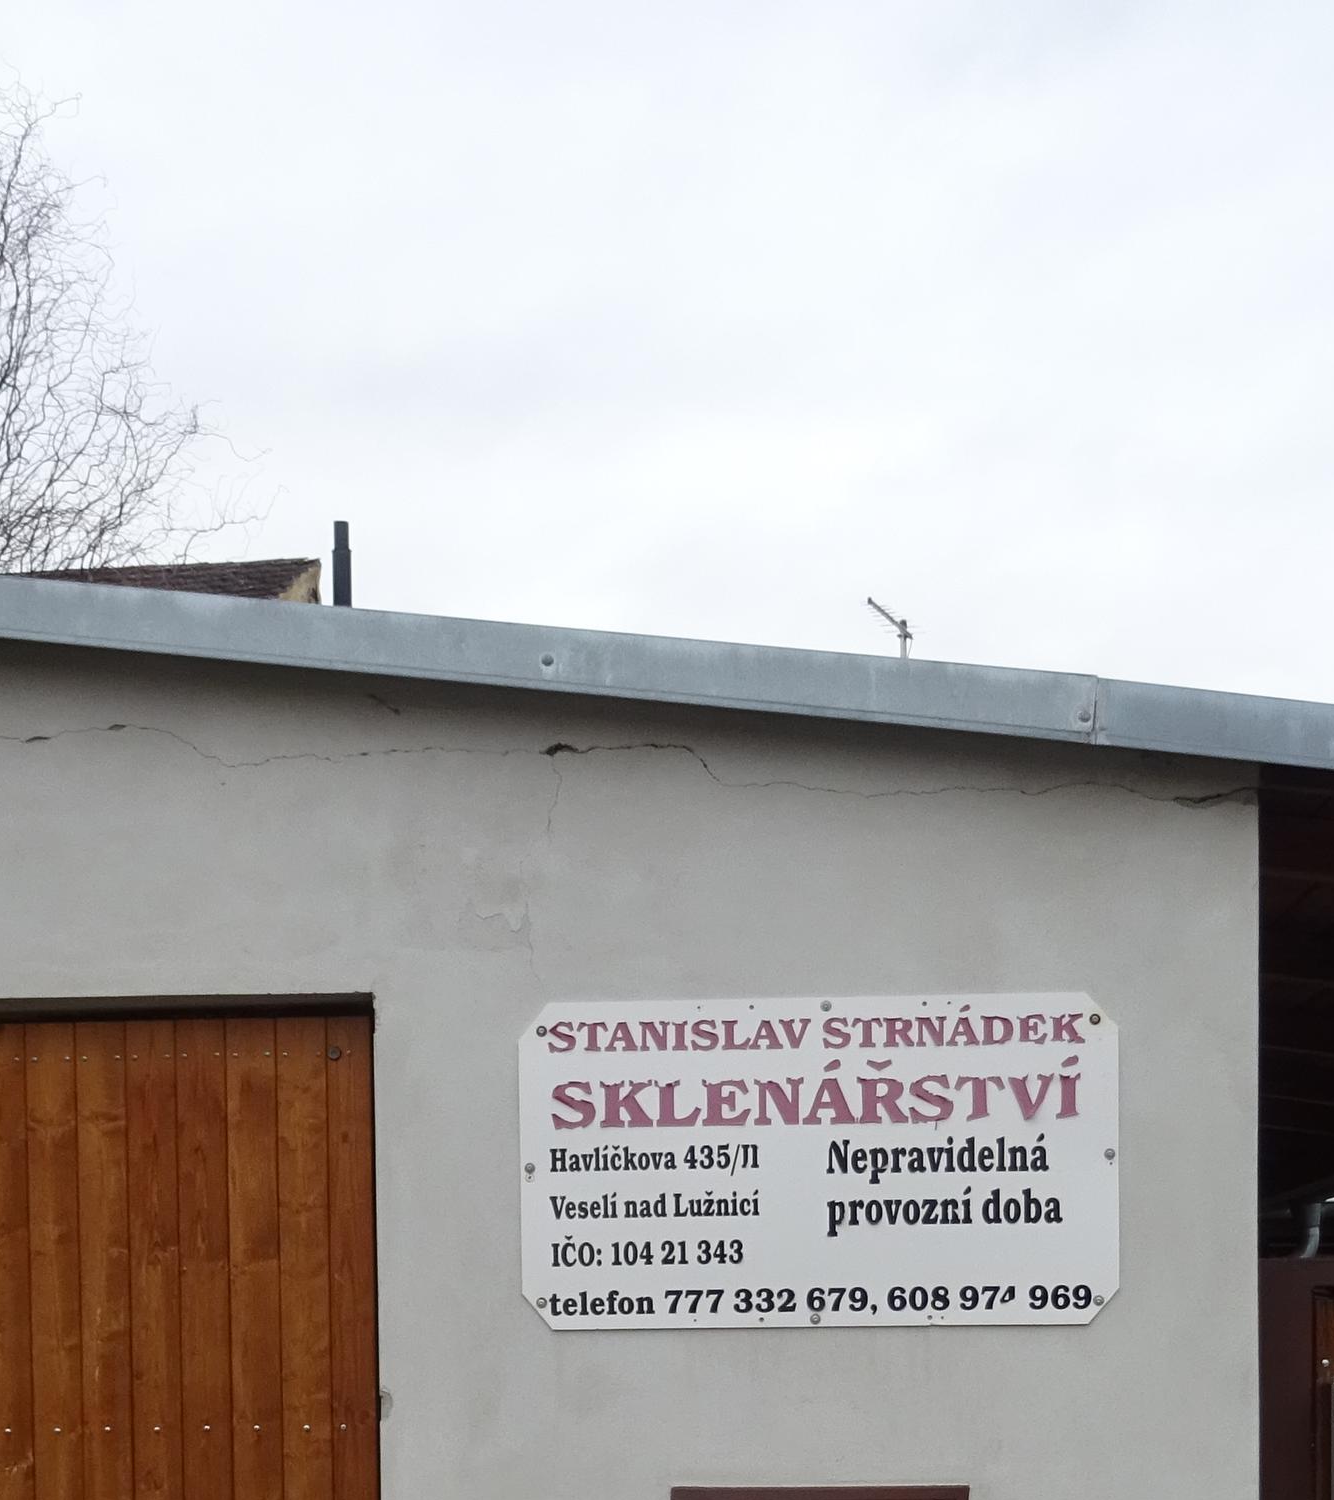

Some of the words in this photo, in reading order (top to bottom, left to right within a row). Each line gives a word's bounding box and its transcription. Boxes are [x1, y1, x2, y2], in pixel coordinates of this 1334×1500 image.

[548, 1018, 811, 1053] STANISLAV
[822, 1004, 1086, 1048] STRNÁDEK
[551, 1055, 1081, 1130] SKLENÁŘSTVÍ
[550, 1144, 677, 1173] Havlíčkova
[826, 1132, 1049, 1184] Nepravidelná
[549, 1192, 618, 1220] Veselí
[624, 1193, 667, 1219] nad
[673, 1189, 760, 1218] Lužnicí
[827, 1186, 972, 1237] provozní
[982, 1187, 1063, 1224] doba
[551, 1235, 603, 1267] IČO:
[611, 1241, 654, 1266] 104
[661, 1240, 689, 1265] 21
[696, 1239, 744, 1265] 343
[549, 1290, 656, 1317] telefon
[664, 1288, 725, 1314] 777
[733, 1287, 797, 1314] 332
[806, 1286, 879, 1315] 679,
[886, 1285, 950, 1312] 608
[1028, 1284, 1093, 1311] 969
